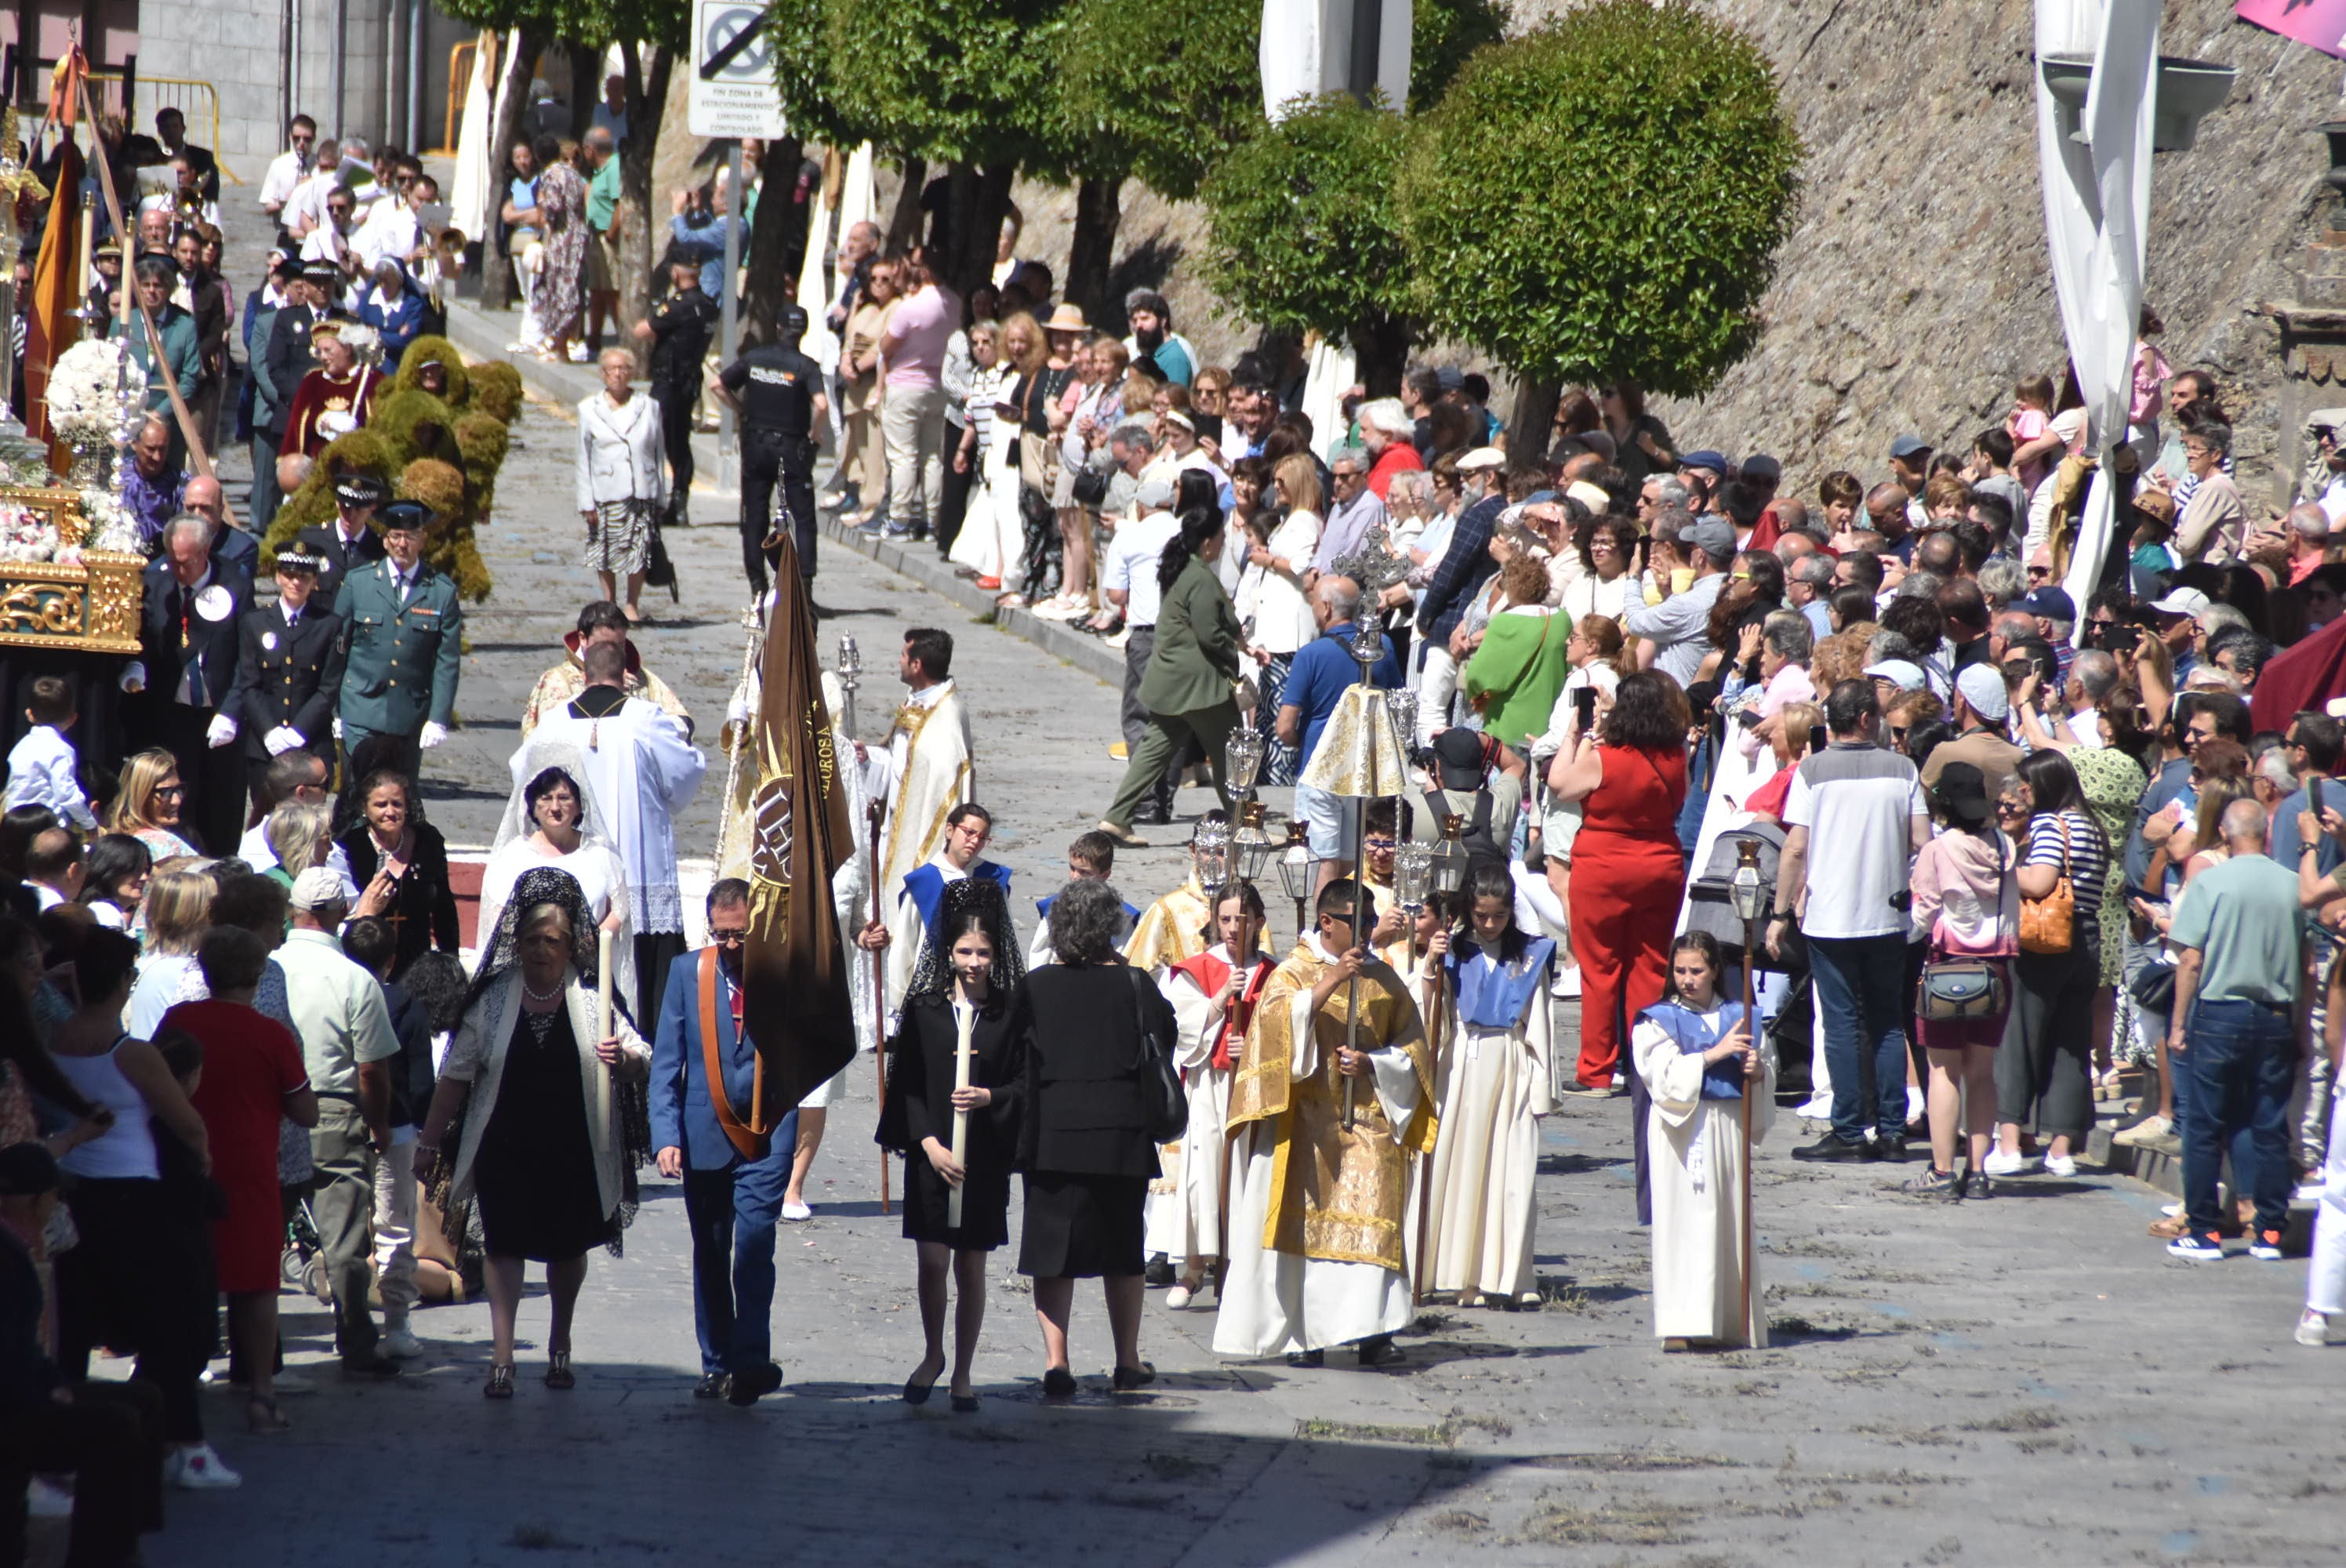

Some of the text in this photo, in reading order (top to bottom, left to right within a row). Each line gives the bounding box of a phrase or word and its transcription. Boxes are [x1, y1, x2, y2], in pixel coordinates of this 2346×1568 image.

[728, 89, 751, 97] ZONA
[754, 89, 763, 98] DE
[702, 100, 774, 111] ESTACIONAMIENTO
[717, 112, 753, 121] LIMITADO
[710, 124, 764, 134] CONTROLADO
